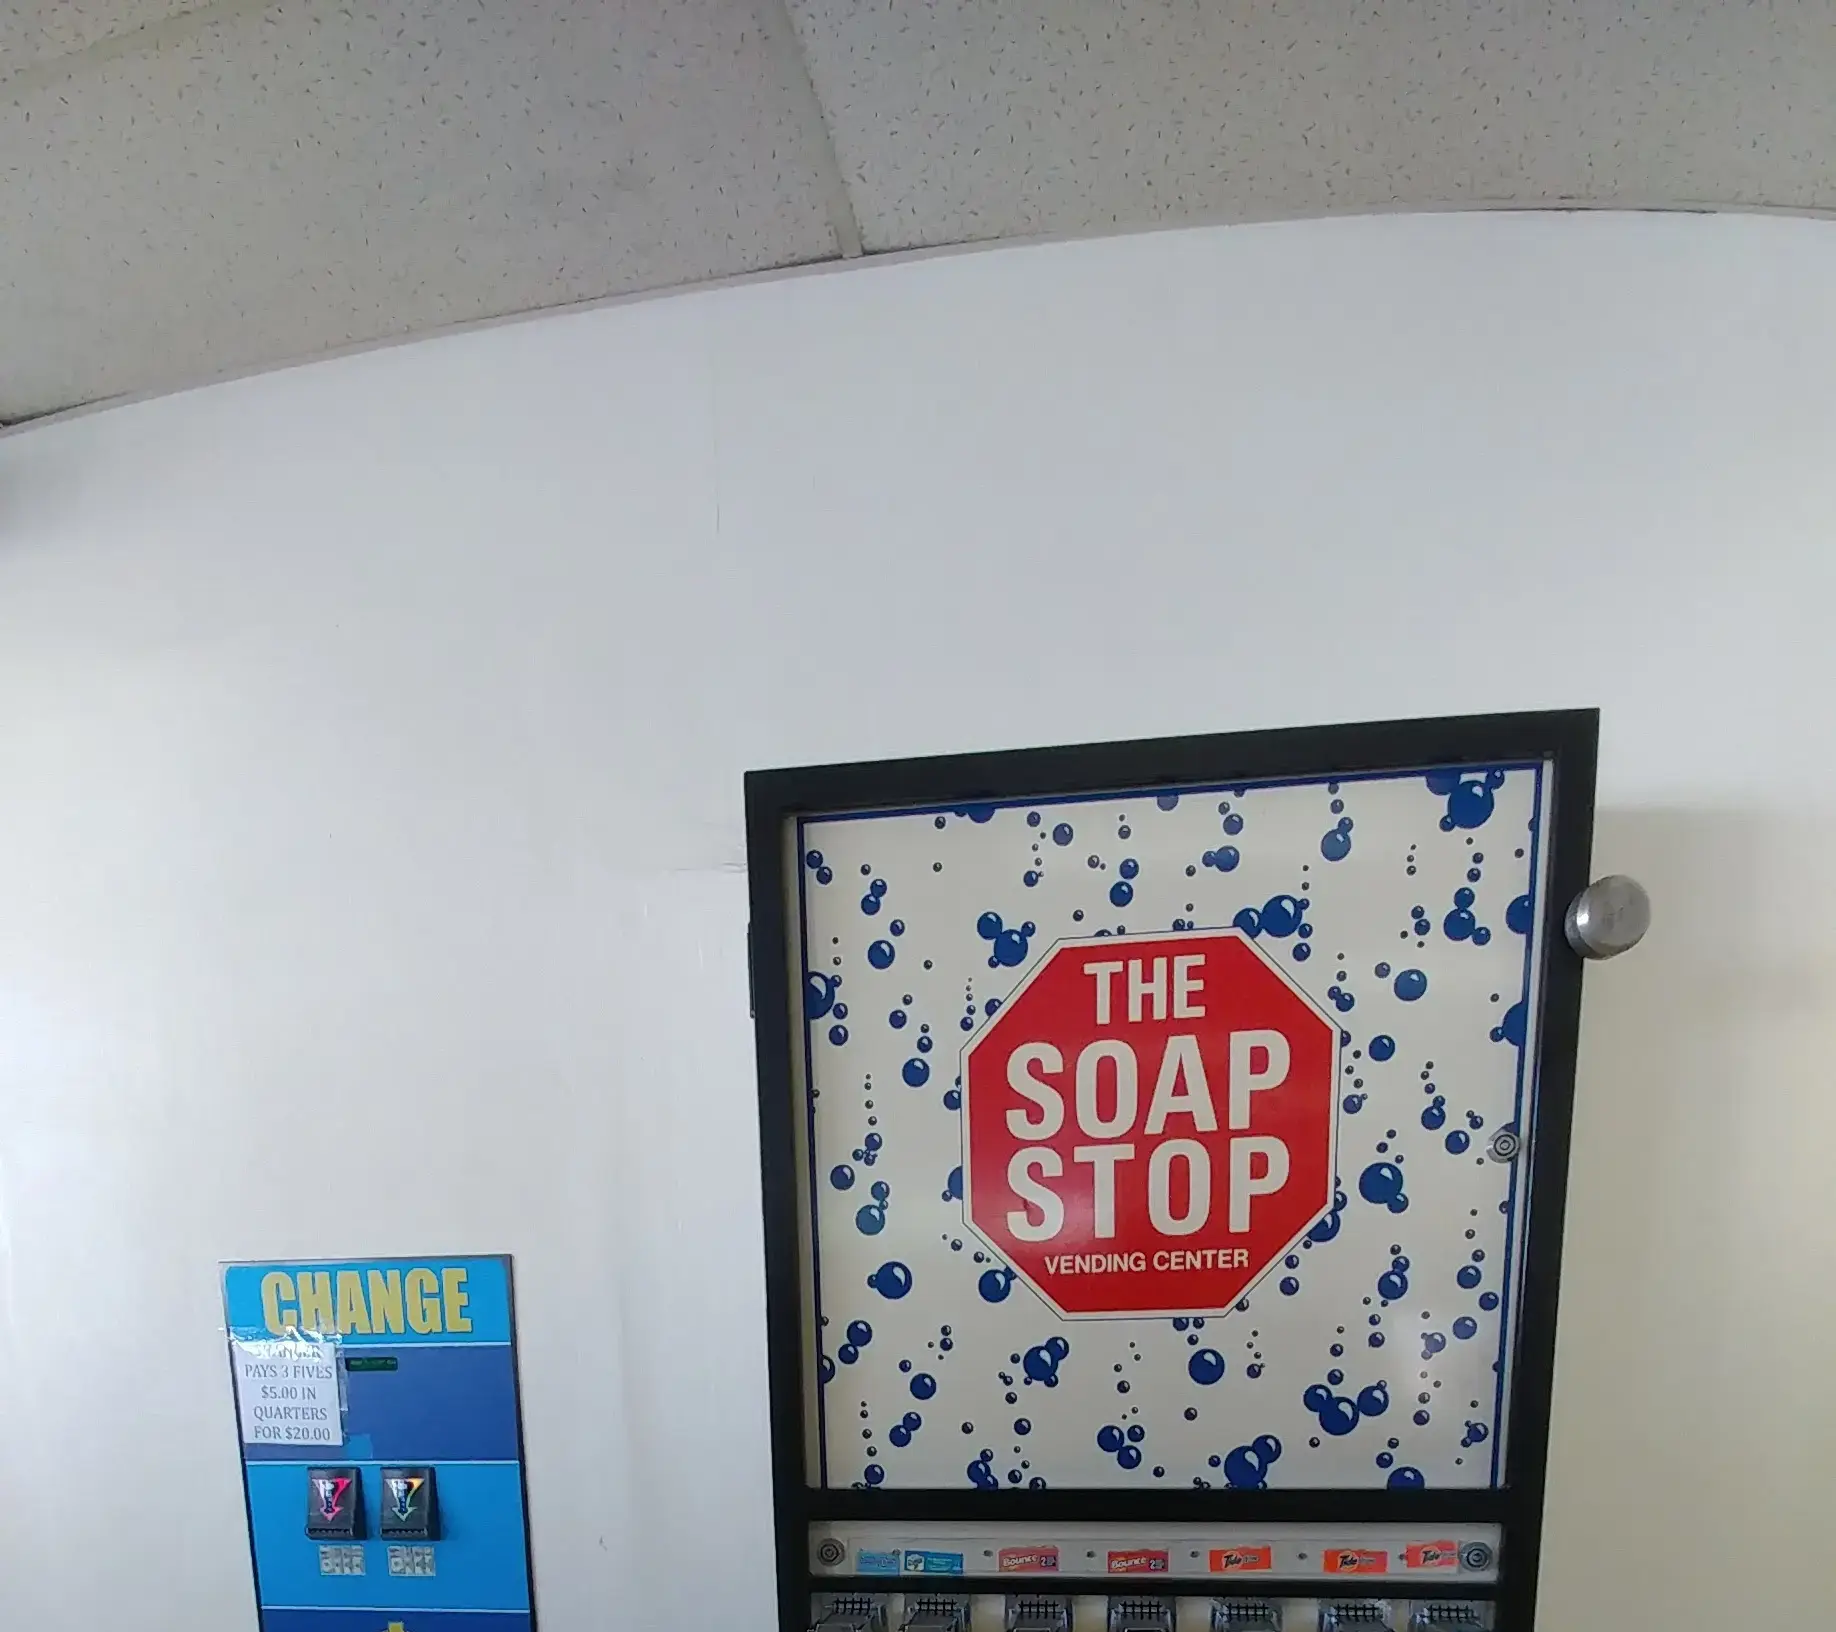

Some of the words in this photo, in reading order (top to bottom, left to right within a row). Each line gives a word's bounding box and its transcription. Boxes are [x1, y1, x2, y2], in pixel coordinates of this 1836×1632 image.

[1083, 953, 1206, 1026] THE
[1005, 1028, 1292, 1141] SOAP
[1006, 1135, 1291, 1243] STOP
[1044, 1251, 1147, 1276] VENDING
[1152, 1248, 1249, 1272] CENTER
[260, 1267, 473, 1336] CHANGE
[245, 1364, 277, 1378] PAYS
[281, 1364, 289, 1378] 3
[293, 1365, 333, 1379] FIVES
[261, 1384, 298, 1400] $5.00
[302, 1386, 317, 1400] IN
[253, 1405, 328, 1422] QUARTERS
[254, 1425, 282, 1440] FOR
[285, 1425, 331, 1441] $20.00
